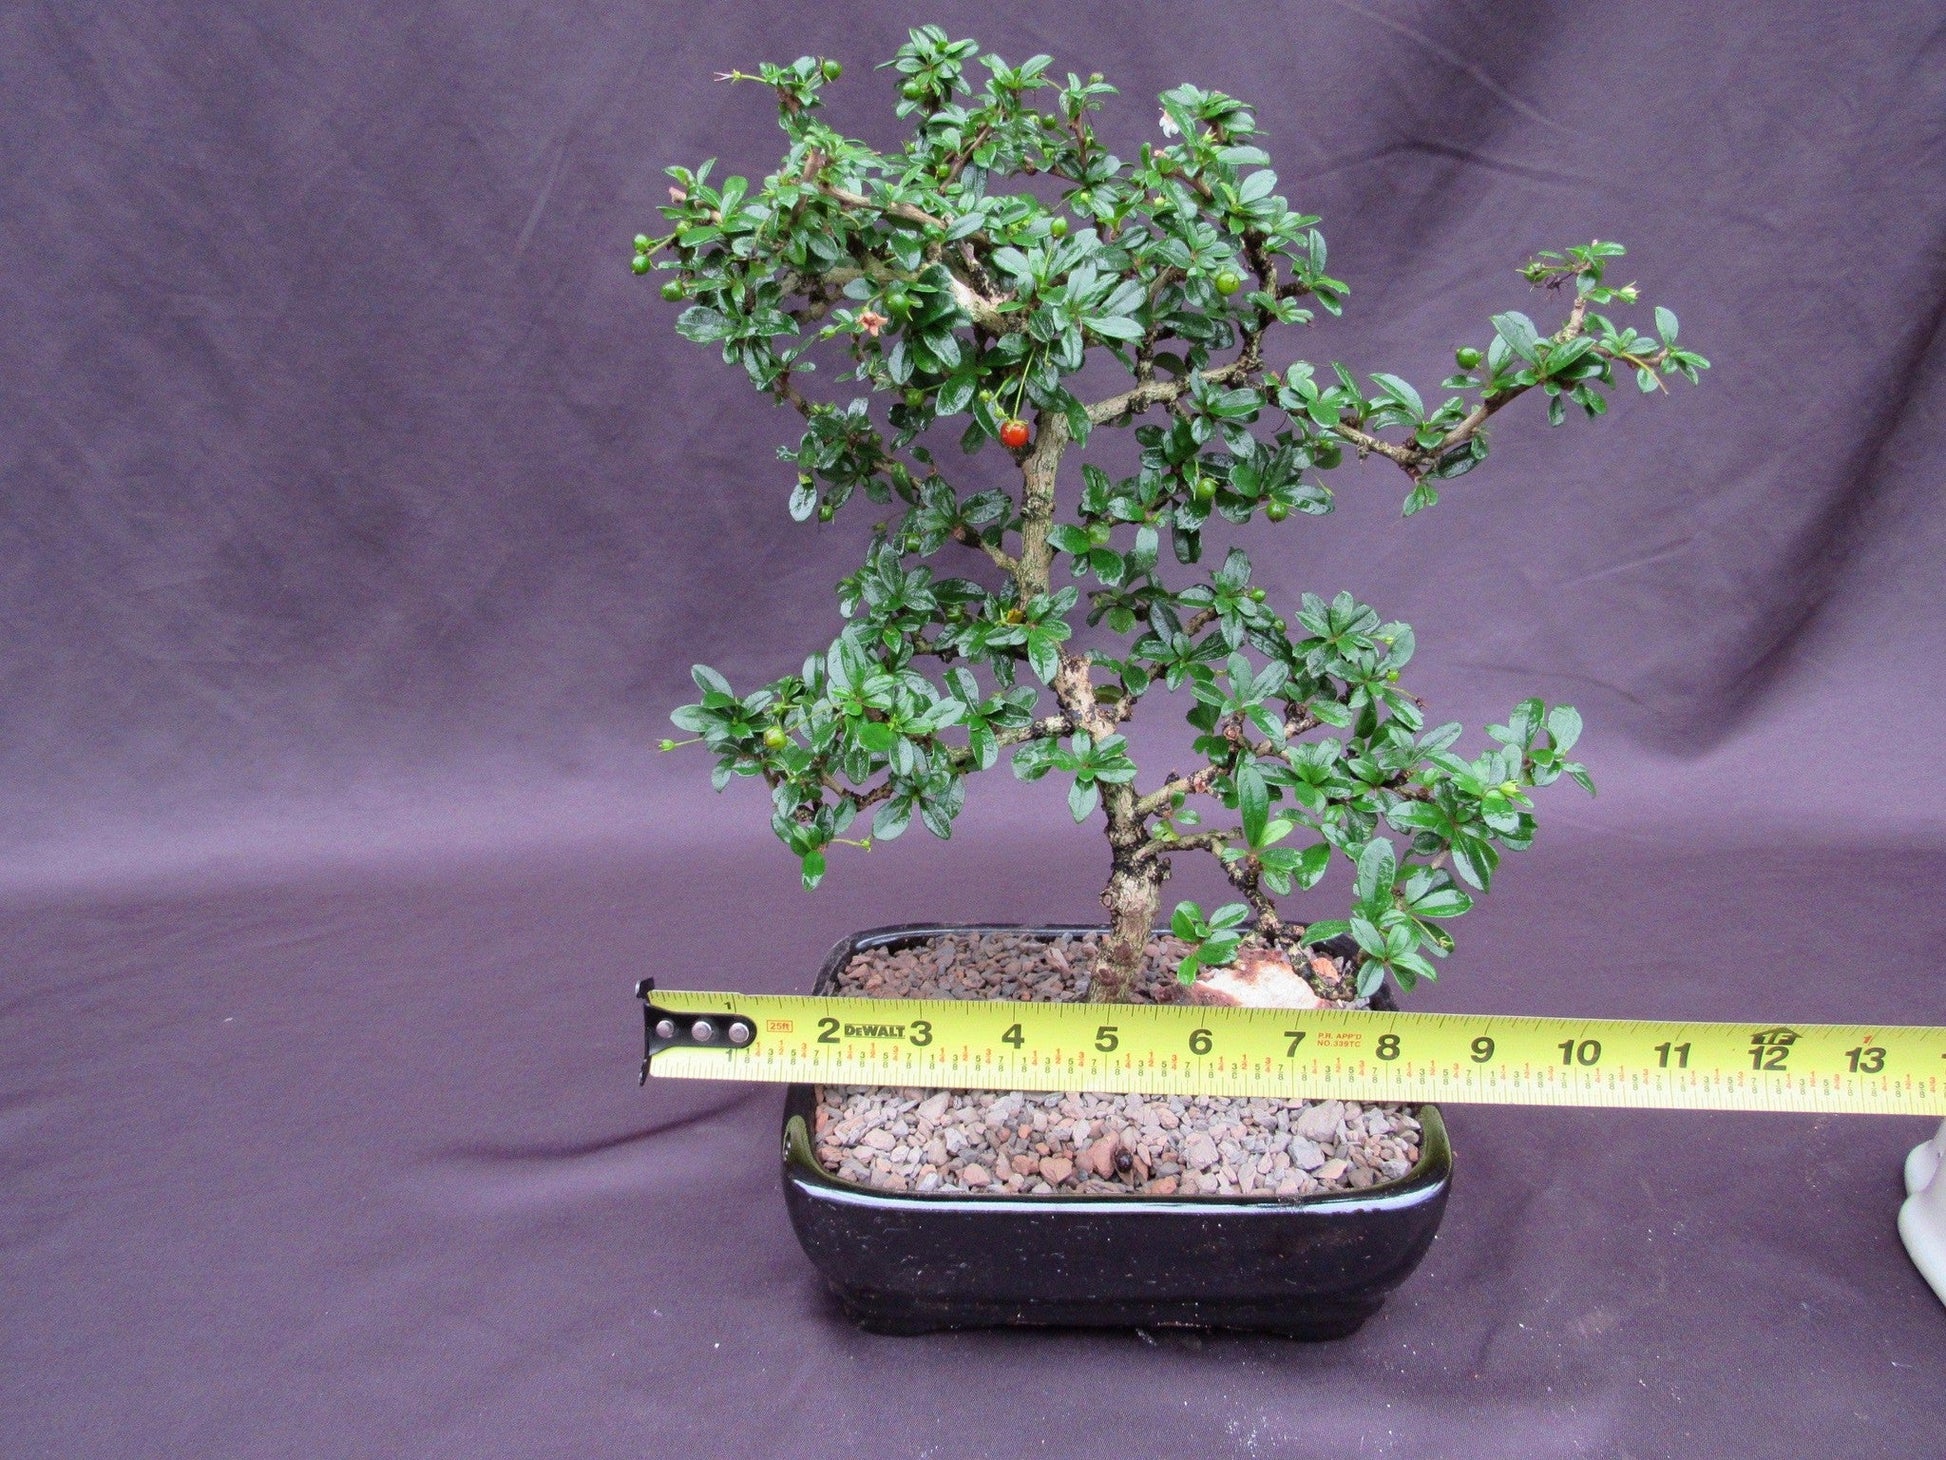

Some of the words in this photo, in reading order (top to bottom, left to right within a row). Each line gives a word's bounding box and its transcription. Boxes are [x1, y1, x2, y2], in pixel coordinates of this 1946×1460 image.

[817, 1017, 840, 1044] 2
[909, 1020, 933, 1047] 3
[1001, 1023, 1025, 1050] 4
[1094, 1026, 1119, 1052] 5
[1189, 1029, 1213, 1055] 6
[1283, 1031, 1306, 1057] 7
[1375, 1034, 1401, 1061] 8
[1470, 1036, 1495, 1063] 9
[1558, 1039, 1602, 1066] 10
[1654, 1042, 1691, 1068] 11
[1748, 1045, 1789, 1071] 12
[1844, 1047, 1886, 1073] 13
